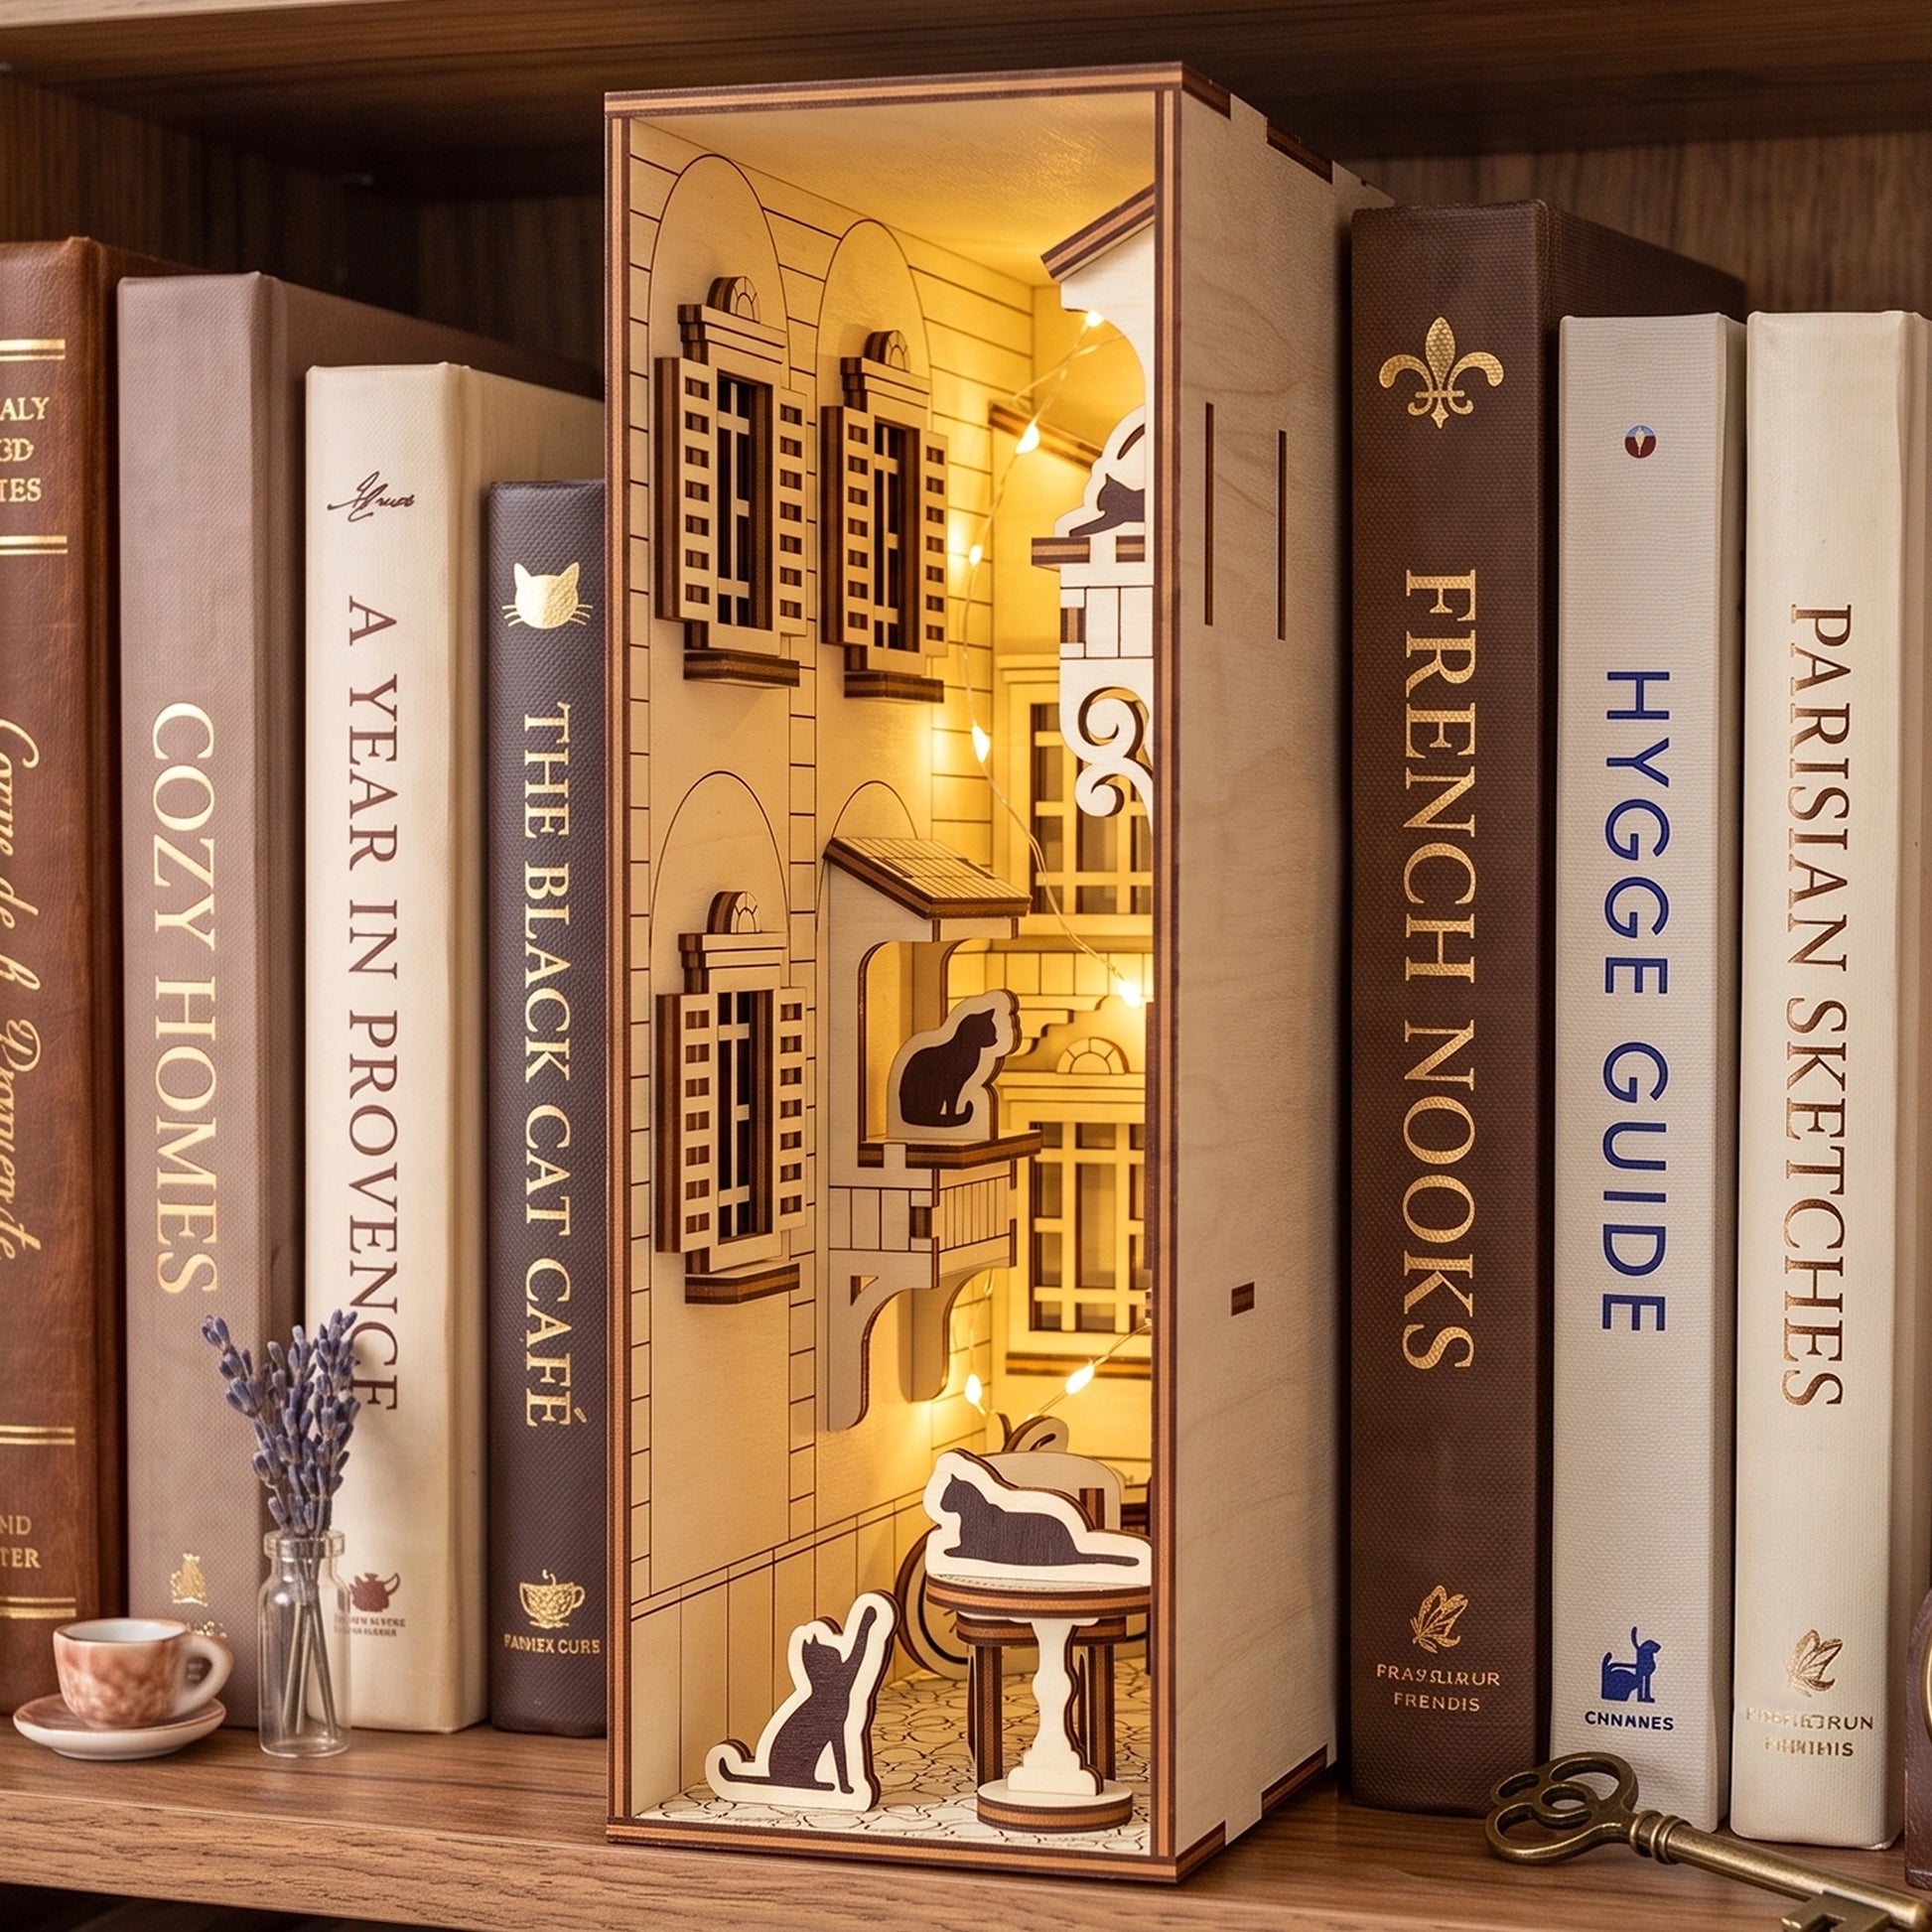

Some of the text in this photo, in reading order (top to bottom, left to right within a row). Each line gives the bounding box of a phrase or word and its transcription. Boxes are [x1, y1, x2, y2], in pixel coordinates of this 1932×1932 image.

[152, 702, 218, 1295] COZY HOMES
[348, 596, 399, 1411] A YEAR IN PROVENCE
[524, 701, 588, 1428] THE BLACK CAT CAFÉ
[1401, 568, 1476, 1370] FRENCH NOOKS
[1600, 670, 1671, 1331] HYGGE GUIDE
[1781, 602, 1853, 1407] PARISIAN SKETCHES
[1393, 1691, 1481, 1713] FRENDIS
